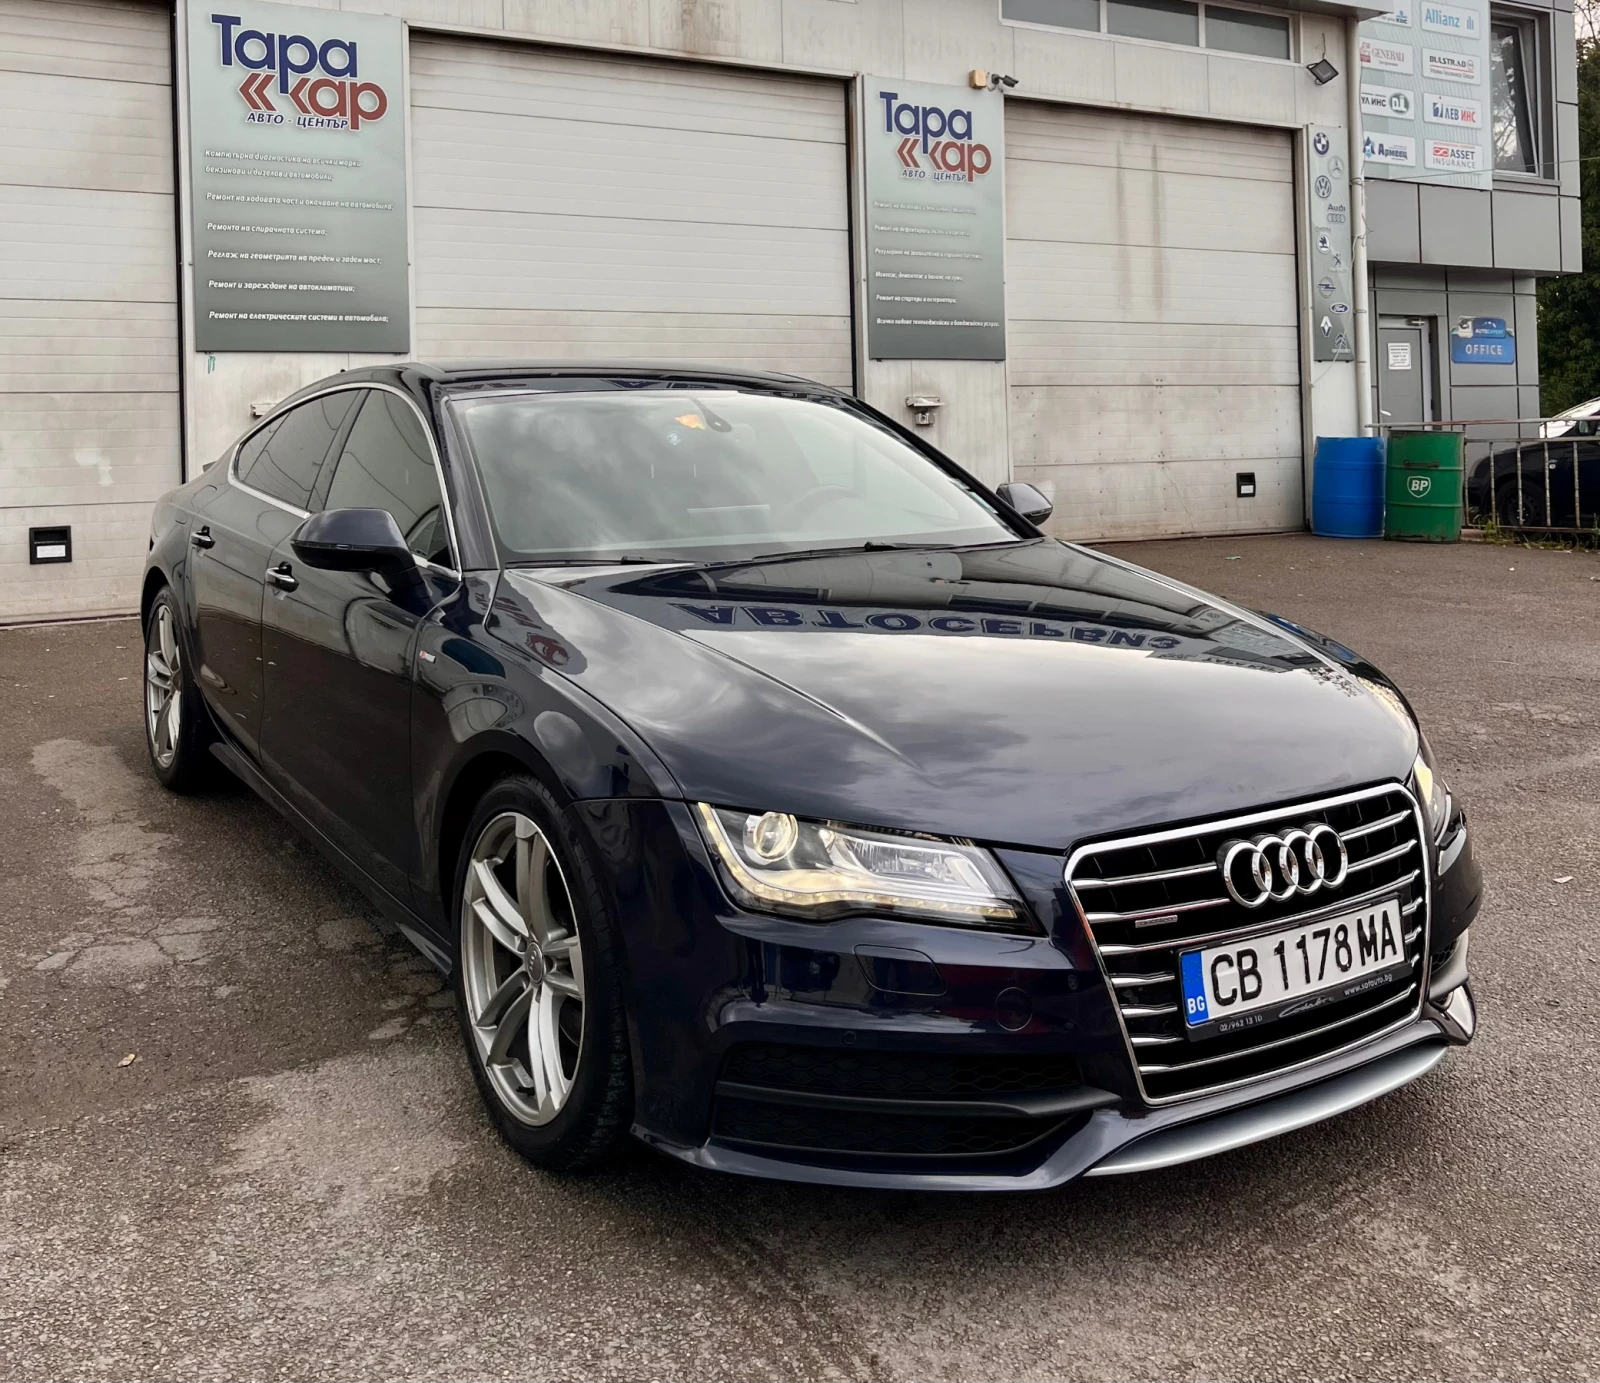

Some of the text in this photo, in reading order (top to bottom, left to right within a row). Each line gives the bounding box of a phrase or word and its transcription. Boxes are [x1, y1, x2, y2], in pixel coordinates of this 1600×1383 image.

[1425, 8, 1461, 28] Allianz
[211, 13, 358, 94] Тара
[1371, 48, 1405, 62] GENERALI
[1371, 98, 1387, 107] ИНС
[246, 112, 284, 124] АВТО
[296, 116, 349, 130] ЦЕНТЪР
[1444, 107, 1476, 123] ЛЕВ ИНС
[879, 91, 973, 154] Тара
[1378, 143, 1408, 160] Армеец
[1450, 149, 1476, 160] ASSET
[302, 156, 311, 164] на
[1433, 158, 1476, 169] INSURANCE
[902, 169, 926, 179] АВТО
[933, 171, 967, 182] ЦЕНТЪР
[206, 192, 235, 201] Ремонт
[282, 197, 298, 205] част
[1327, 203, 1346, 212] Audi
[251, 225, 295, 235] спирачната
[207, 250, 239, 259] Реглаж
[250, 252, 297, 262] геометрията
[308, 254, 335, 263] преден
[208, 280, 237, 288] Ремонт
[243, 281, 288, 290] зареждане
[209, 311, 238, 319] Ремонт
[249, 313, 307, 321] електрическите
[1465, 344, 1503, 355] OFFICE
[1411, 479, 1429, 491] BP
[1210, 909, 1398, 1007] CB 1178 MA
[1186, 995, 1206, 1014] BG
